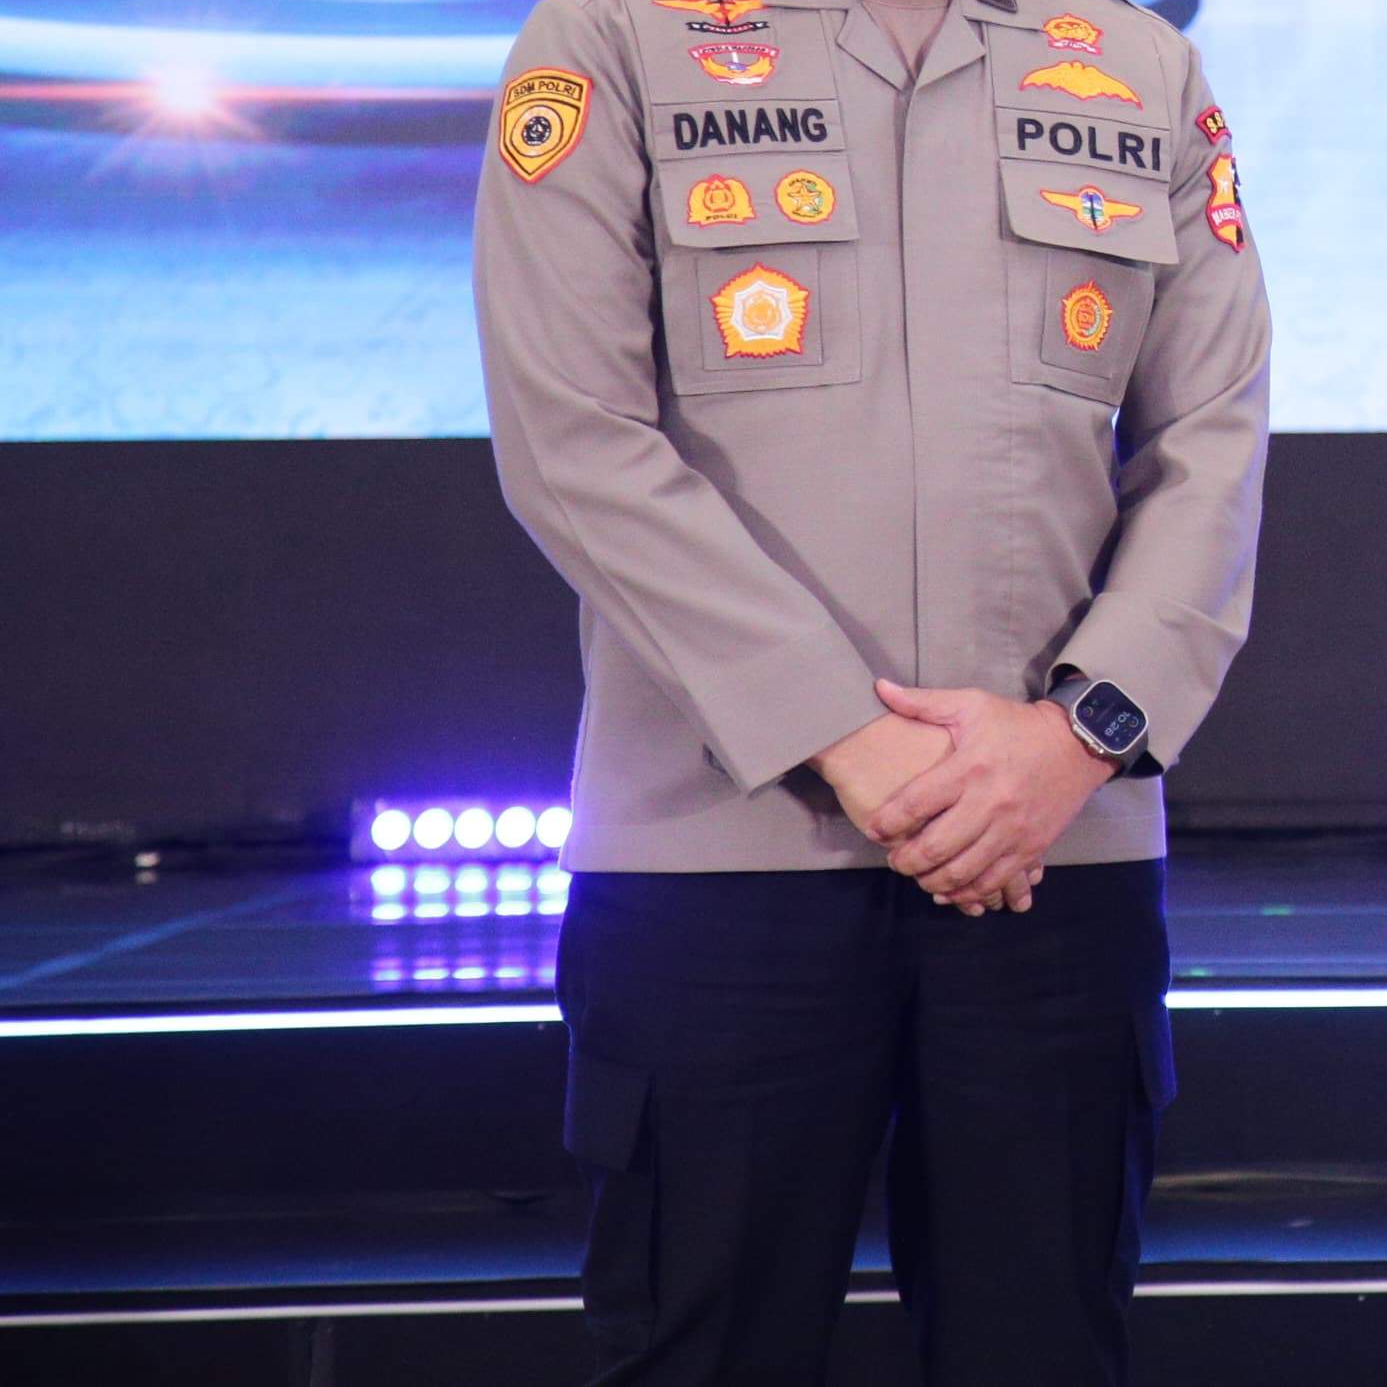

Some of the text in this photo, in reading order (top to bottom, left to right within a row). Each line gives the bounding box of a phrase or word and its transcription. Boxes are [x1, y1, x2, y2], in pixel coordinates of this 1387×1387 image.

[513, 80, 577, 98] SDM POLRI
[673, 108, 828, 151] DANANG
[1017, 117, 1161, 172] POLRI
